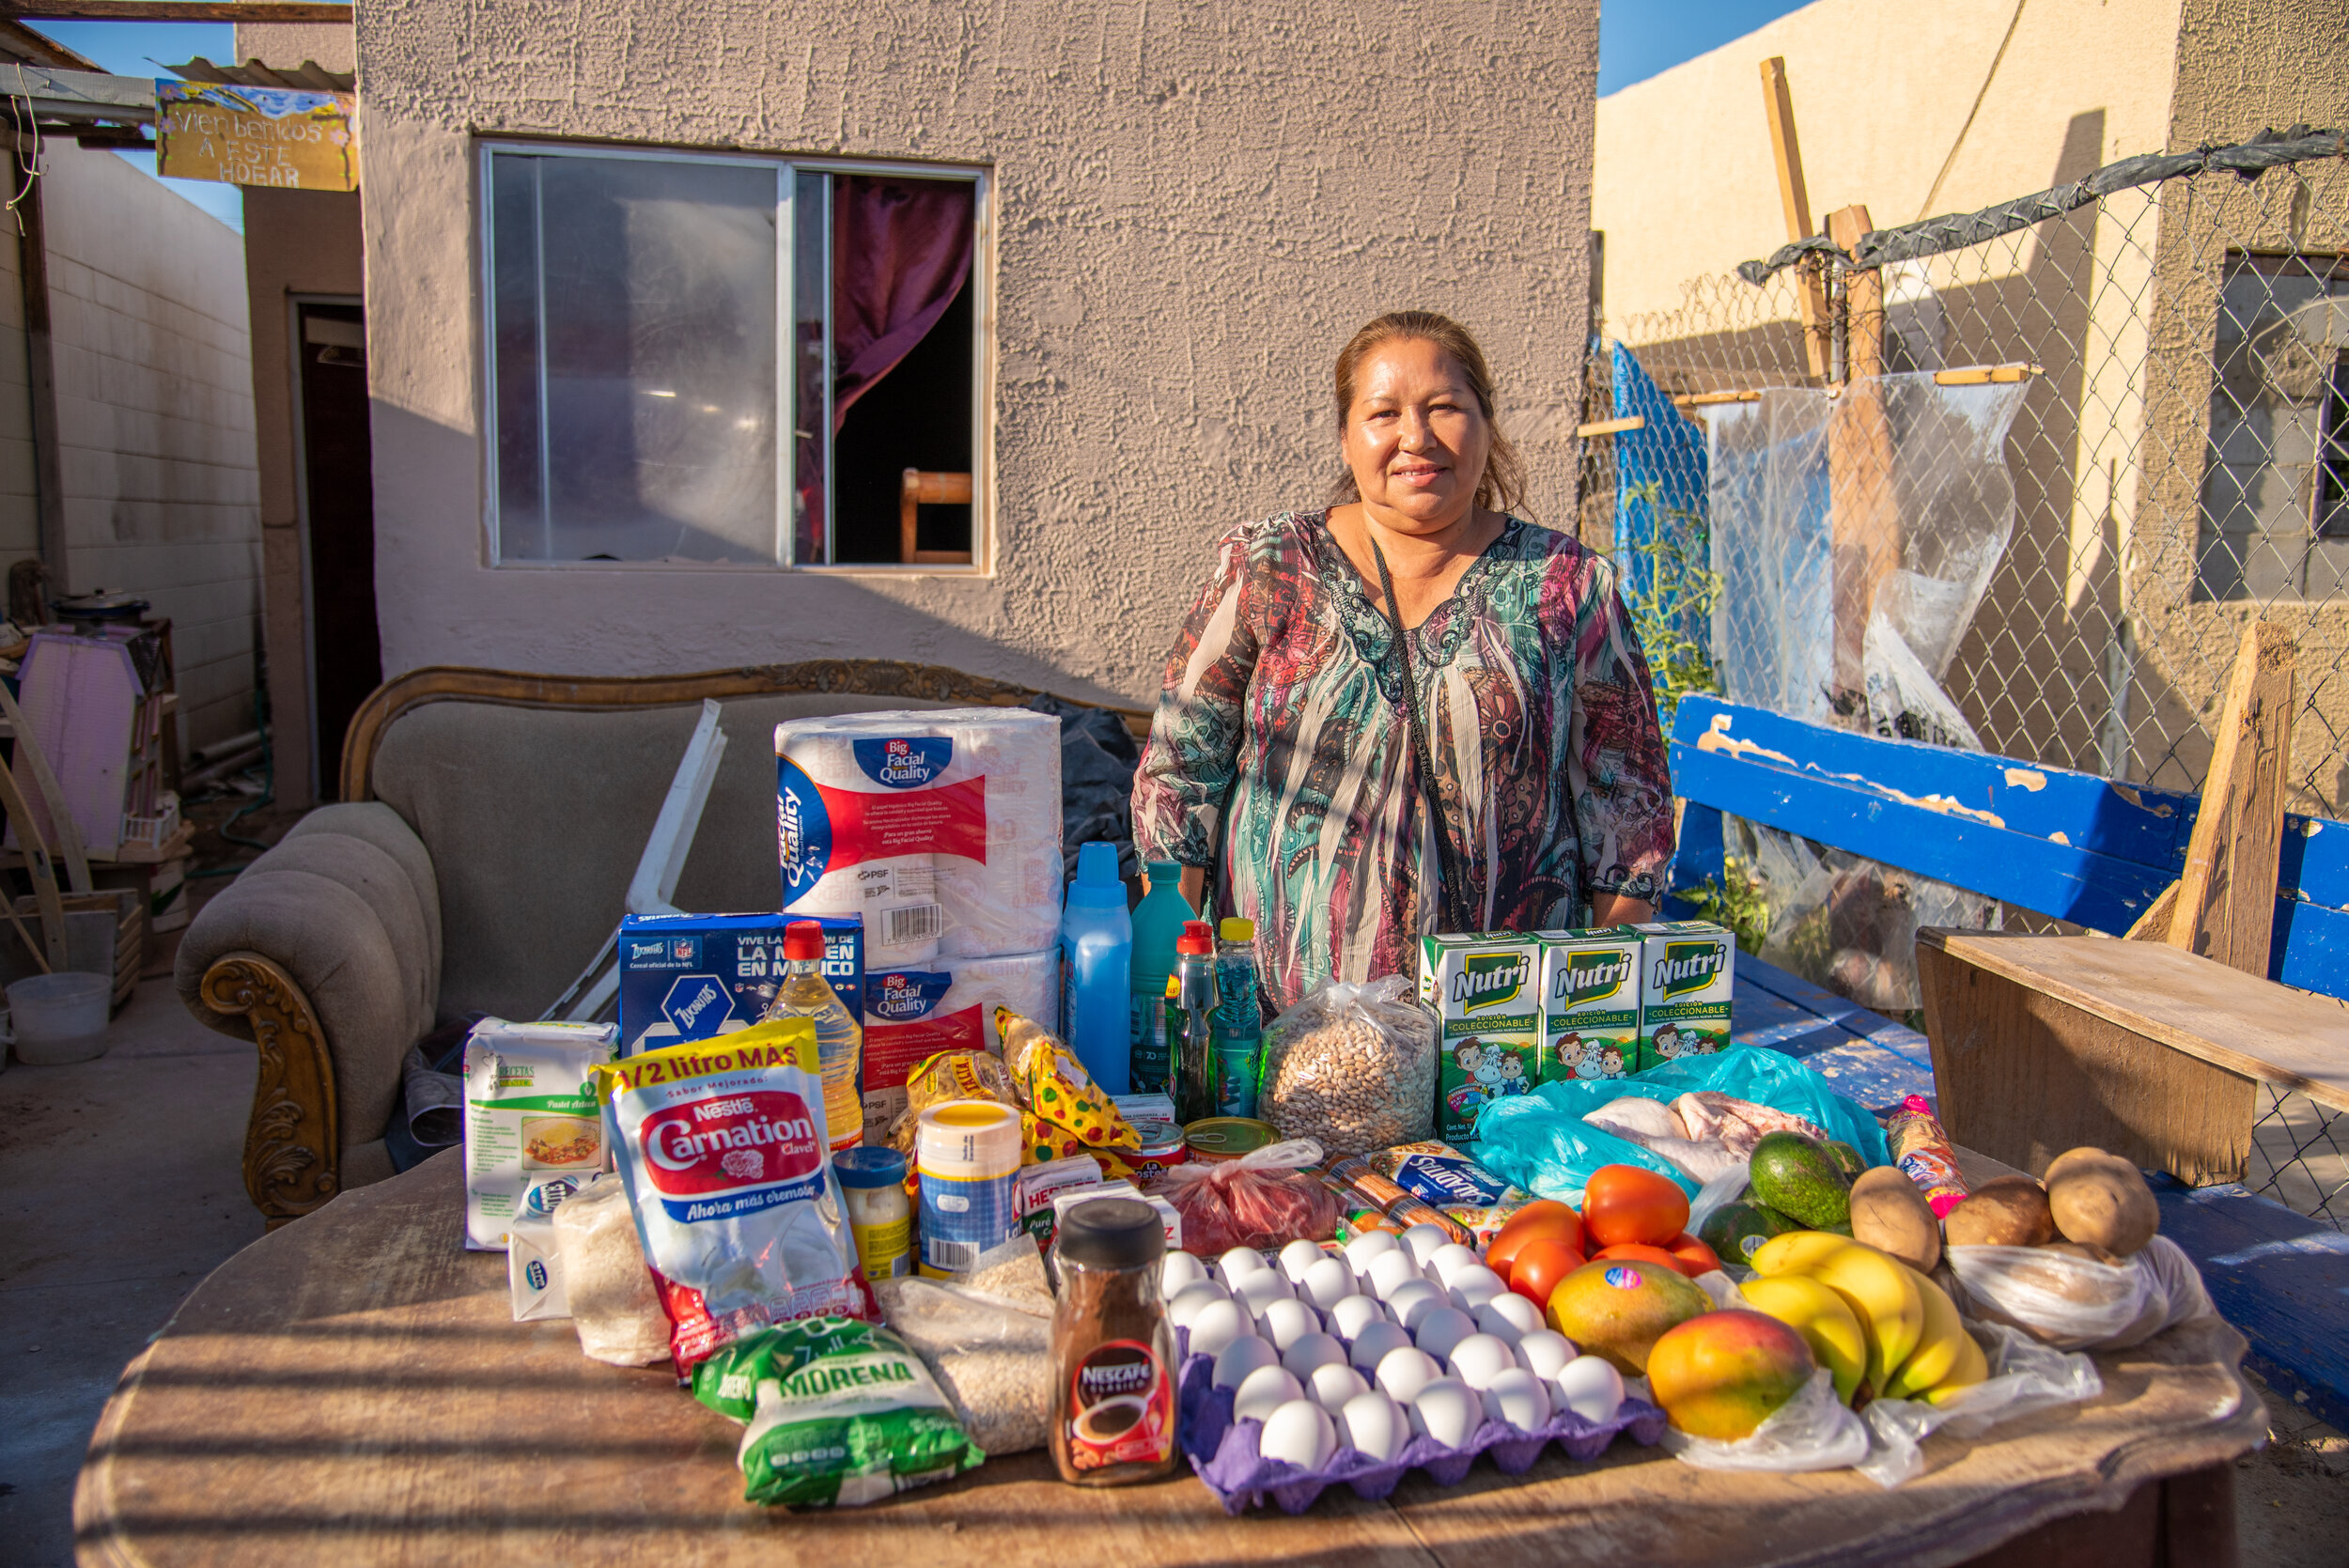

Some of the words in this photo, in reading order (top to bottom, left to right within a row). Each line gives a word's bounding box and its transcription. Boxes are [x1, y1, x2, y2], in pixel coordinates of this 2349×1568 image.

[199, 137, 215, 158] A
[226, 141, 291, 167] ESTE
[889, 740, 908, 755] Big
[887, 751, 926, 768] Facial
[879, 765, 930, 784] Quality
[785, 786, 804, 888] Quality
[871, 869, 889, 879] PSF
[738, 937, 764, 945] VIVE
[768, 936, 783, 944] LA
[738, 946, 768, 961] LA
[738, 961, 766, 977] EN
[1653, 943, 1727, 989] Nutri
[887, 976, 905, 988] Big
[1453, 955, 1531, 1003] Nutri
[1555, 953, 1633, 999] Nutri
[884, 985, 922, 1000] Facial
[878, 999, 926, 1017] Quality
[1146, 1052, 1157, 1060] 70
[500, 1066, 534, 1076] RECETAS
[618, 1062, 666, 1089] 1/2
[668, 1053, 734, 1082] litro
[738, 1043, 799, 1069] MÁS
[666, 1086, 704, 1098] Sabor
[869, 1099, 887, 1109] PSF
[648, 1115, 813, 1171] Carnation
[1409, 1157, 1496, 1203] SALADITAS
[687, 1199, 732, 1221] Ahora
[735, 1192, 764, 1211] más
[1030, 1216, 1051, 1229] Puré
[779, 1362, 916, 1399] MORENA
